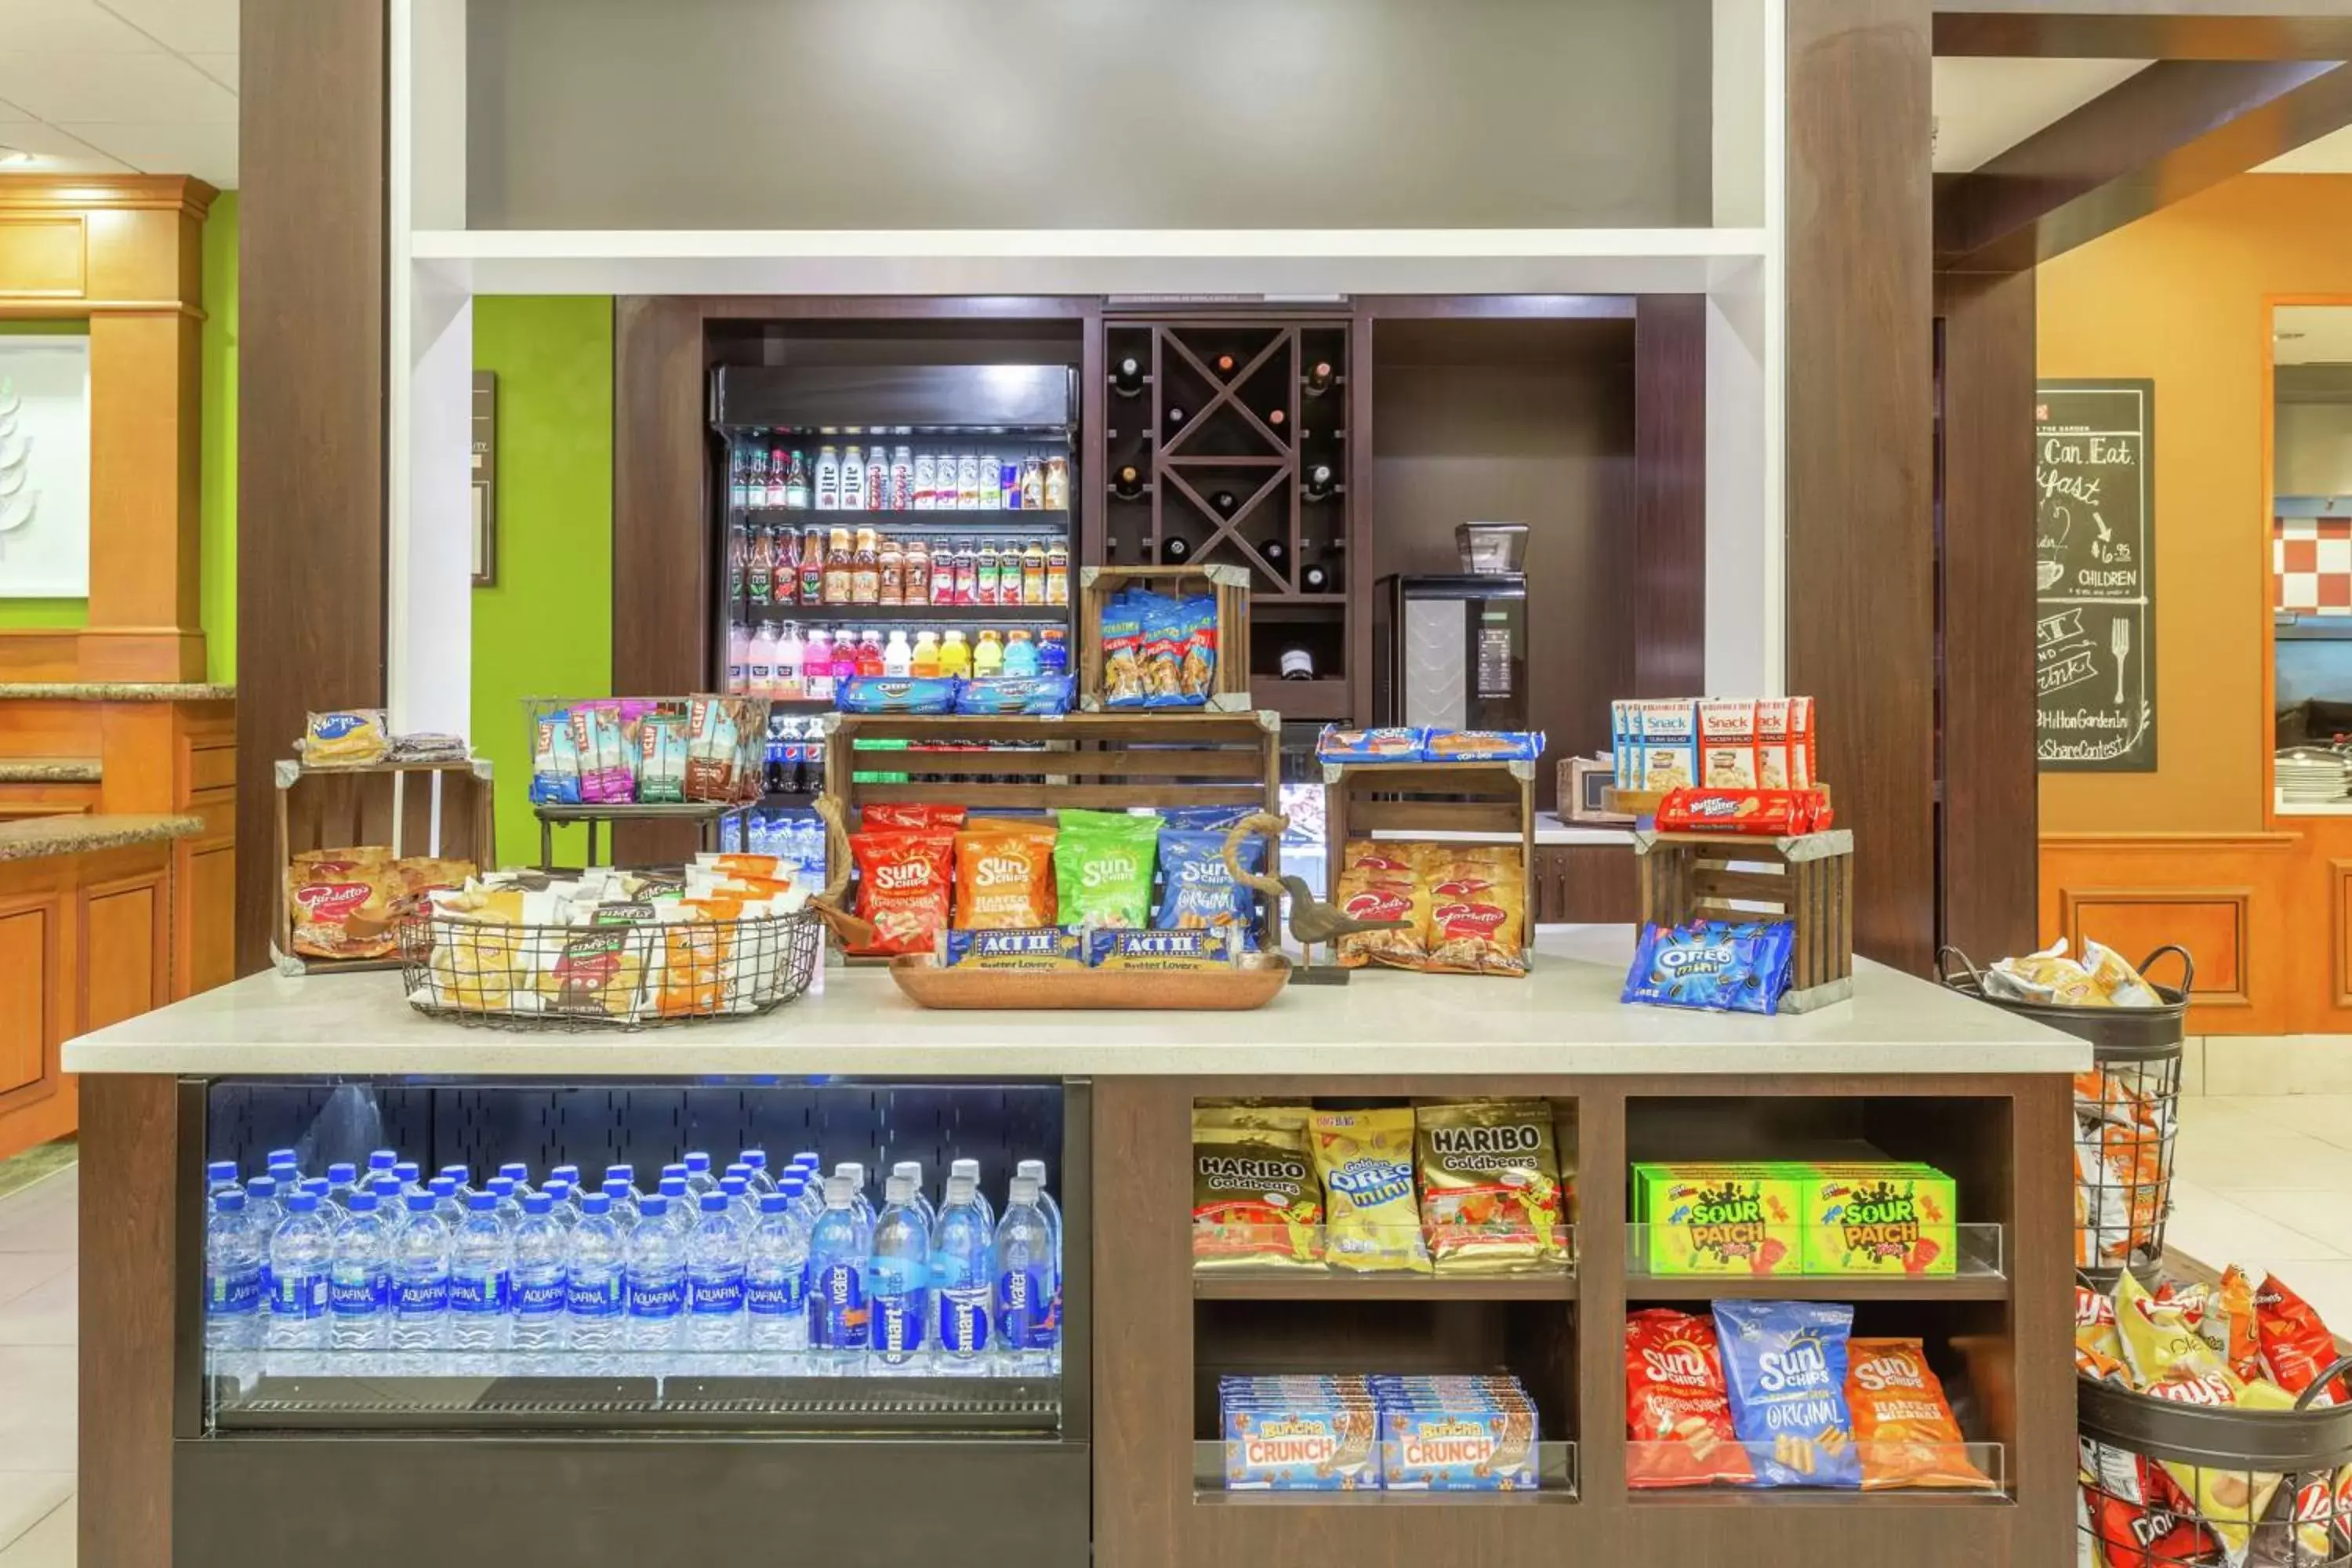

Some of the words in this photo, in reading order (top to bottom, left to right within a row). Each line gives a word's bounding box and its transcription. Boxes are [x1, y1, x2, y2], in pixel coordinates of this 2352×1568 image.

[821, 467, 837, 492] Lite
[845, 467, 861, 493] Lite
[2078, 569, 2136, 586] CHILDREN
[691, 702, 706, 729] CLIF
[1648, 717, 1686, 728] Snack
[1708, 717, 1748, 729] Snack
[644, 727, 655, 750] CLIF
[877, 862, 930, 889] Sun
[894, 877, 929, 887] CHIPS
[975, 858, 1030, 886] Sun
[995, 873, 1029, 883] CHIPS
[1081, 858, 1135, 887] Sun
[1102, 873, 1135, 883] CHIPS
[1182, 860, 1230, 882] Sun
[984, 935, 1025, 952] ACT
[1029, 935, 1051, 950] II
[1127, 938, 1167, 952] ACT
[1171, 937, 1193, 950] II
[1661, 949, 1732, 967] OREO
[1675, 964, 1719, 978] mini
[1433, 1126, 1540, 1152] HARIBO
[1201, 1157, 1305, 1179] HARIBO
[1344, 1160, 1392, 1173] Golden
[1443, 1156, 1537, 1171] Goldbears
[1209, 1177, 1300, 1196] Goldbears
[1330, 1164, 1412, 1190] OREO
[1354, 1180, 1407, 1205] mini
[1693, 1202, 1760, 1225] SOUR
[1846, 1201, 1913, 1224] SOUR
[1690, 1222, 1766, 1247] PATCH
[1844, 1221, 1918, 1247] PATCH
[832, 1267, 848, 1305] water
[1010, 1272, 1025, 1310] water
[633, 1291, 680, 1306] AQUAFINA
[887, 1308, 903, 1363] smart
[956, 1303, 974, 1356] smart
[1643, 1348, 1707, 1381] Sun
[1759, 1346, 1825, 1391] Sun
[1855, 1358, 1919, 1390] Sun
[1670, 1374, 1707, 1386] CHIPS
[1785, 1369, 1829, 1387] CHIPS
[1884, 1375, 1924, 1388] CHIPS
[1767, 1398, 1844, 1429] ORIGINAL
[1249, 1439, 1333, 1464] CRUNCH
[1406, 1440, 1490, 1465] CRUNCH
